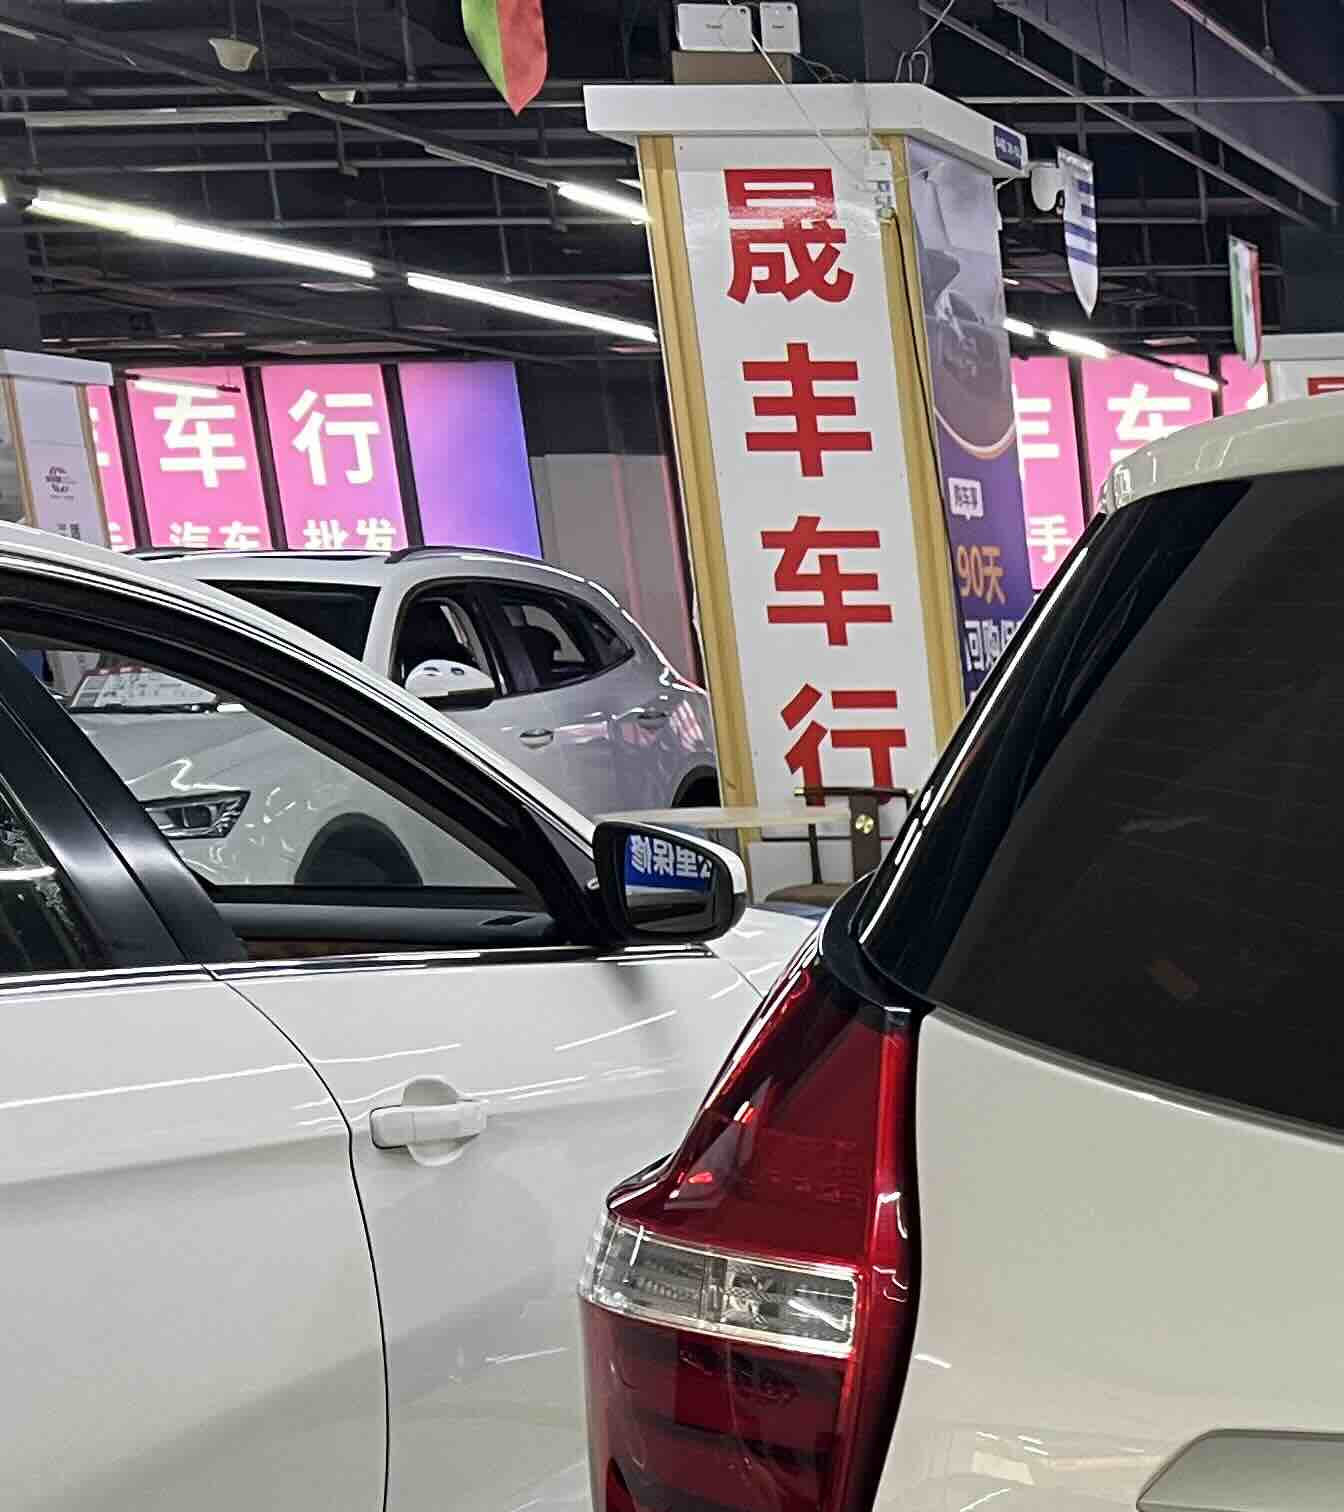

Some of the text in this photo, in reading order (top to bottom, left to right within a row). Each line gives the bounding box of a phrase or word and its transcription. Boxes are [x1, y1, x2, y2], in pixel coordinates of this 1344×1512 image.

[722, 167, 907, 807] 晟丰车行
[956, 543, 1007, 605] 90天
